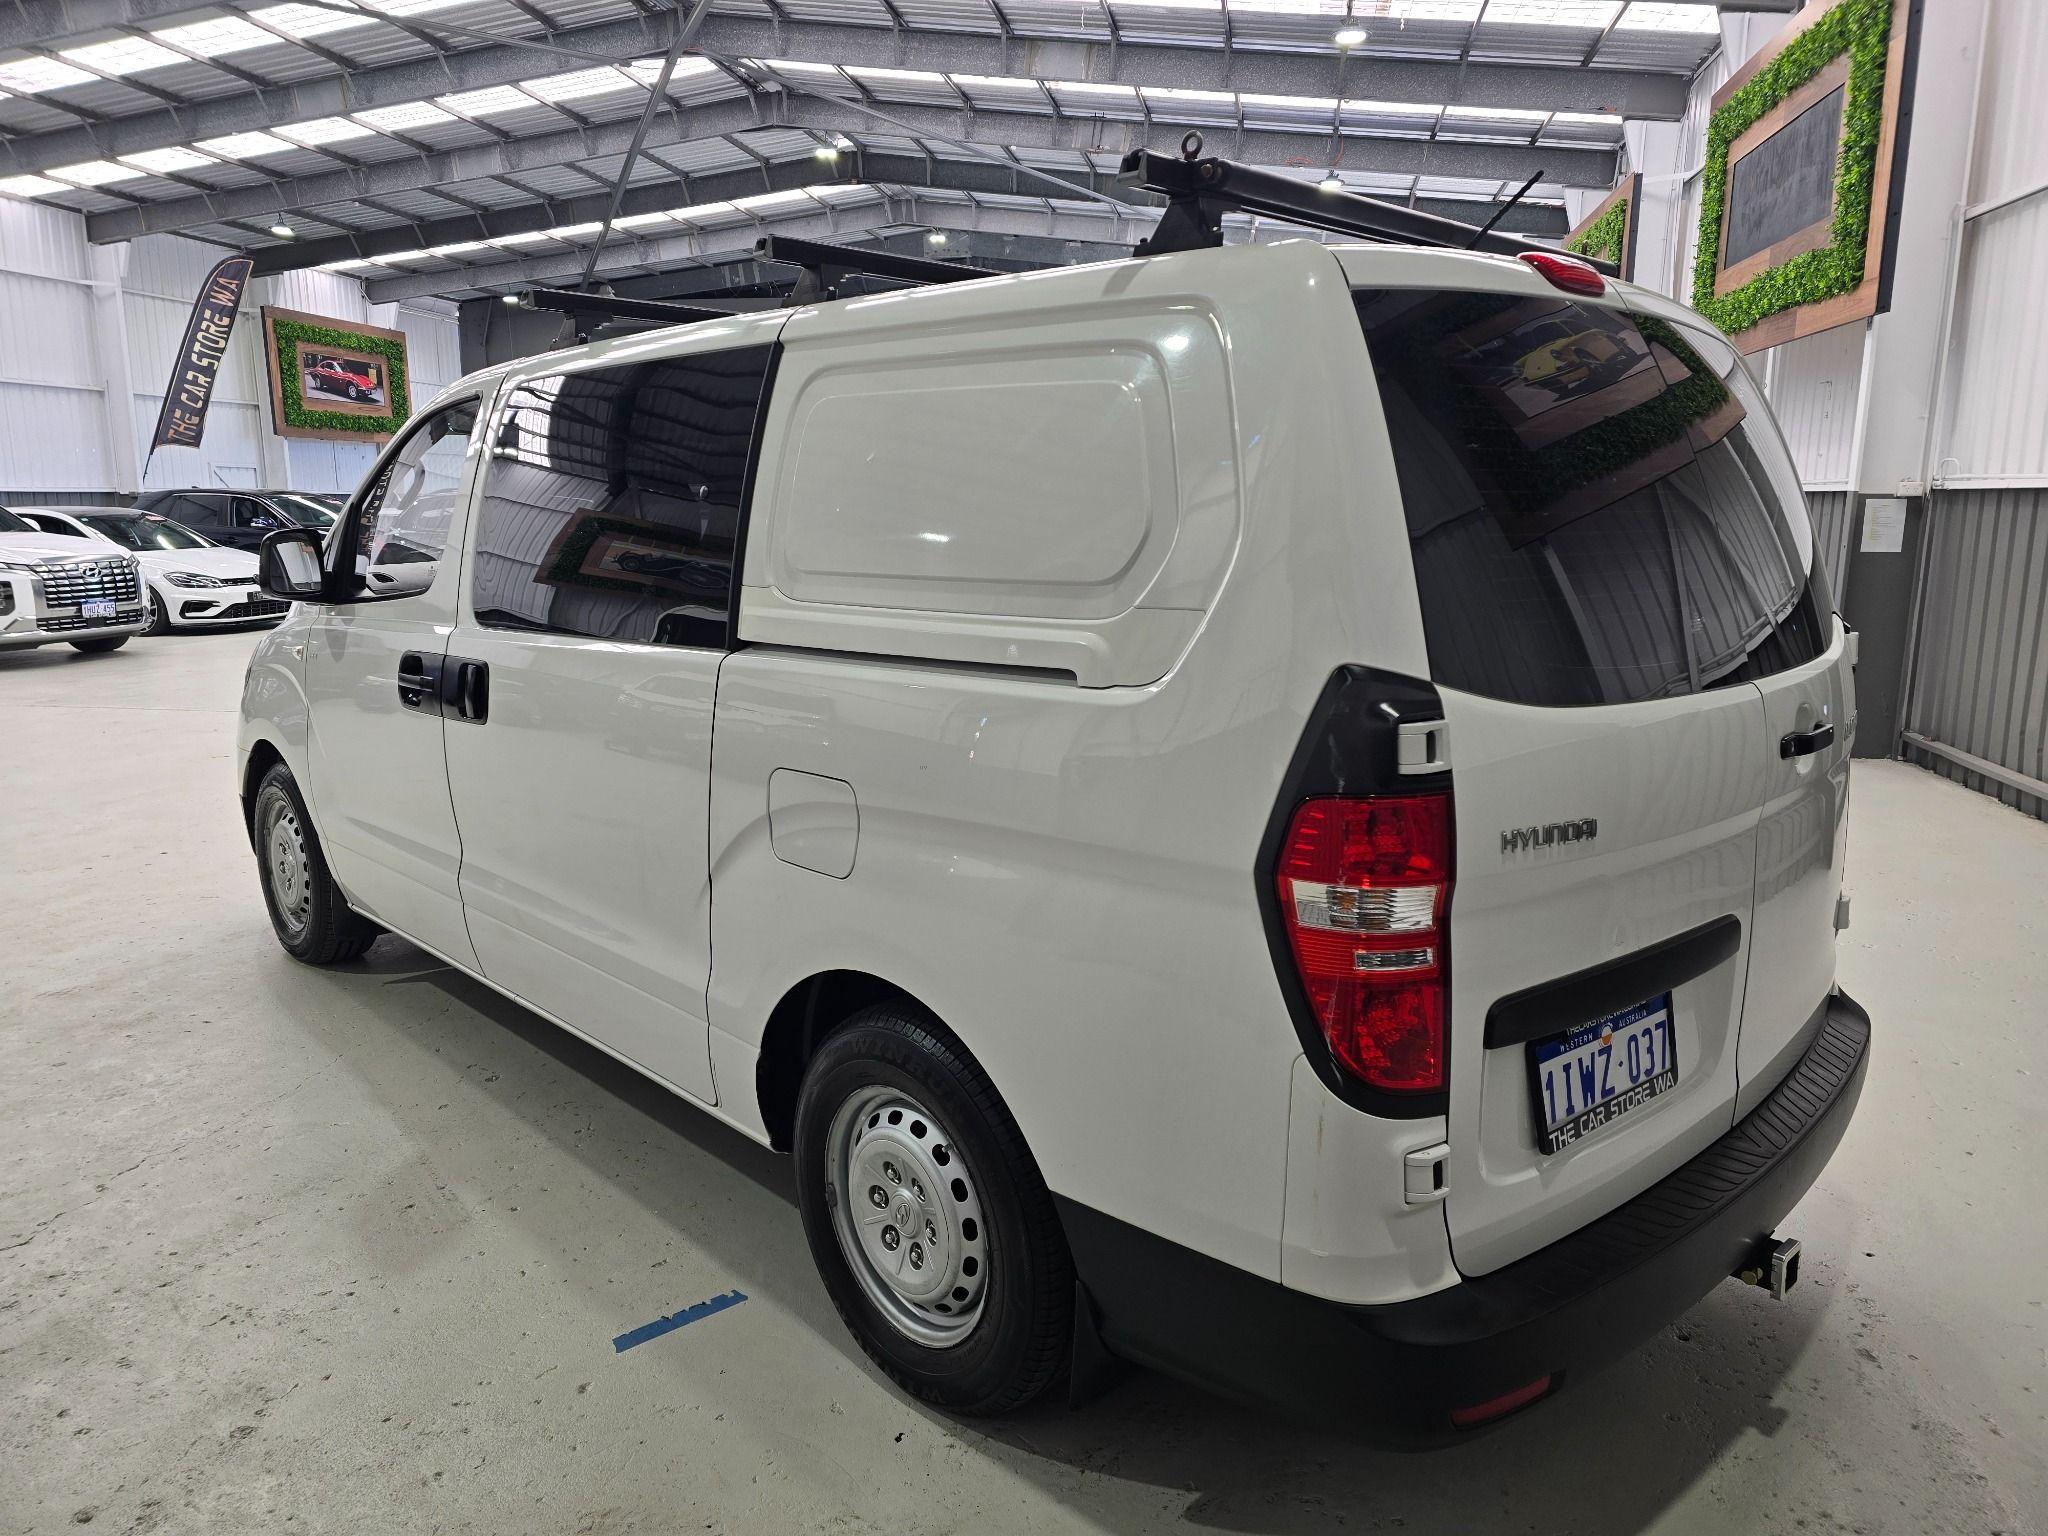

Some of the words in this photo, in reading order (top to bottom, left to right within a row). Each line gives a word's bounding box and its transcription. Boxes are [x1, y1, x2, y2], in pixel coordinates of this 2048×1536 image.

[209, 277, 240, 307] WA
[191, 308, 231, 370] STORE
[181, 370, 212, 409] CAR
[167, 408, 200, 444] THE
[1501, 818, 1597, 854] HYUNDAI
[1560, 1033, 1593, 1052] WESTERN
[1619, 1009, 1647, 1028] AUSTRALIA
[1549, 1123, 1576, 1152] THE
[1580, 1107, 1605, 1135] CAR
[1610, 1083, 1651, 1120] STORE
[1654, 1071, 1675, 1095] WA
